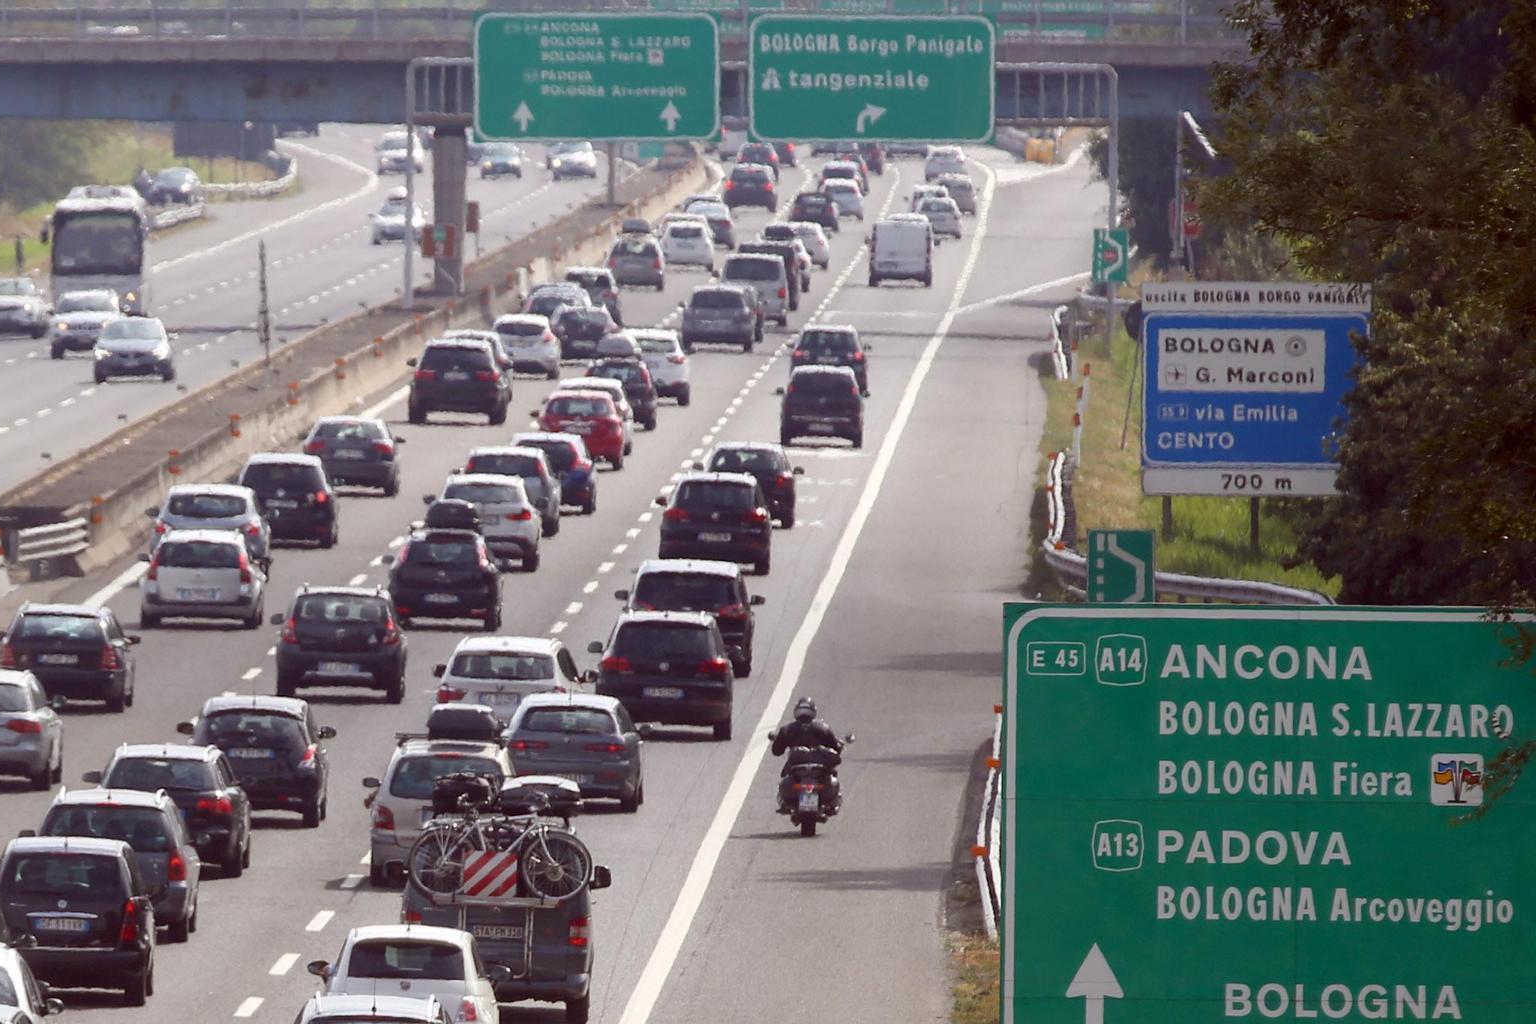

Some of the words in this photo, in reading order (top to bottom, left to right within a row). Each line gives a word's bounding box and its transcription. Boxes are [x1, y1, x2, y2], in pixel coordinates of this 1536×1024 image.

[540, 22, 599, 32] ANCONA
[540, 36, 604, 47] BOLOGNA
[760, 34, 840, 52] BOLOGNA
[848, 34, 898, 56] Borgo
[906, 34, 983, 57] Panigale
[540, 51, 604, 62] BOLOGNA
[541, 70, 592, 81] PADOVA
[789, 69, 929, 91] tangenziale
[540, 85, 604, 96] BOLOGNA
[1146, 291, 1187, 303] uscita
[1194, 291, 1250, 303] BOLOGNA
[1259, 291, 1301, 304] BORGO
[1165, 338, 1275, 354] BOLOGNA
[1196, 367, 1216, 383] G.
[1227, 367, 1315, 384] Marconi
[1195, 404, 1224, 420] via
[1233, 404, 1298, 421] Emilia
[1158, 432, 1234, 449] CENTO
[1221, 474, 1262, 489] 700
[1275, 478, 1292, 489] m
[1033, 650, 1046, 667] E
[1055, 649, 1079, 668] 45
[1099, 647, 1142, 672] A14
[1160, 644, 1372, 680] ANCONA
[1160, 701, 1318, 737] BOLOGNA
[1159, 760, 1317, 796] BOLOGNA
[1333, 762, 1412, 797] Fiera
[1097, 832, 1139, 857] A13
[1157, 829, 1351, 865] PADOVA
[1157, 885, 1316, 922] BOLOGNA
[1330, 887, 1513, 932] Arcoveggio
[1224, 983, 1462, 1019] BOLOGNA
